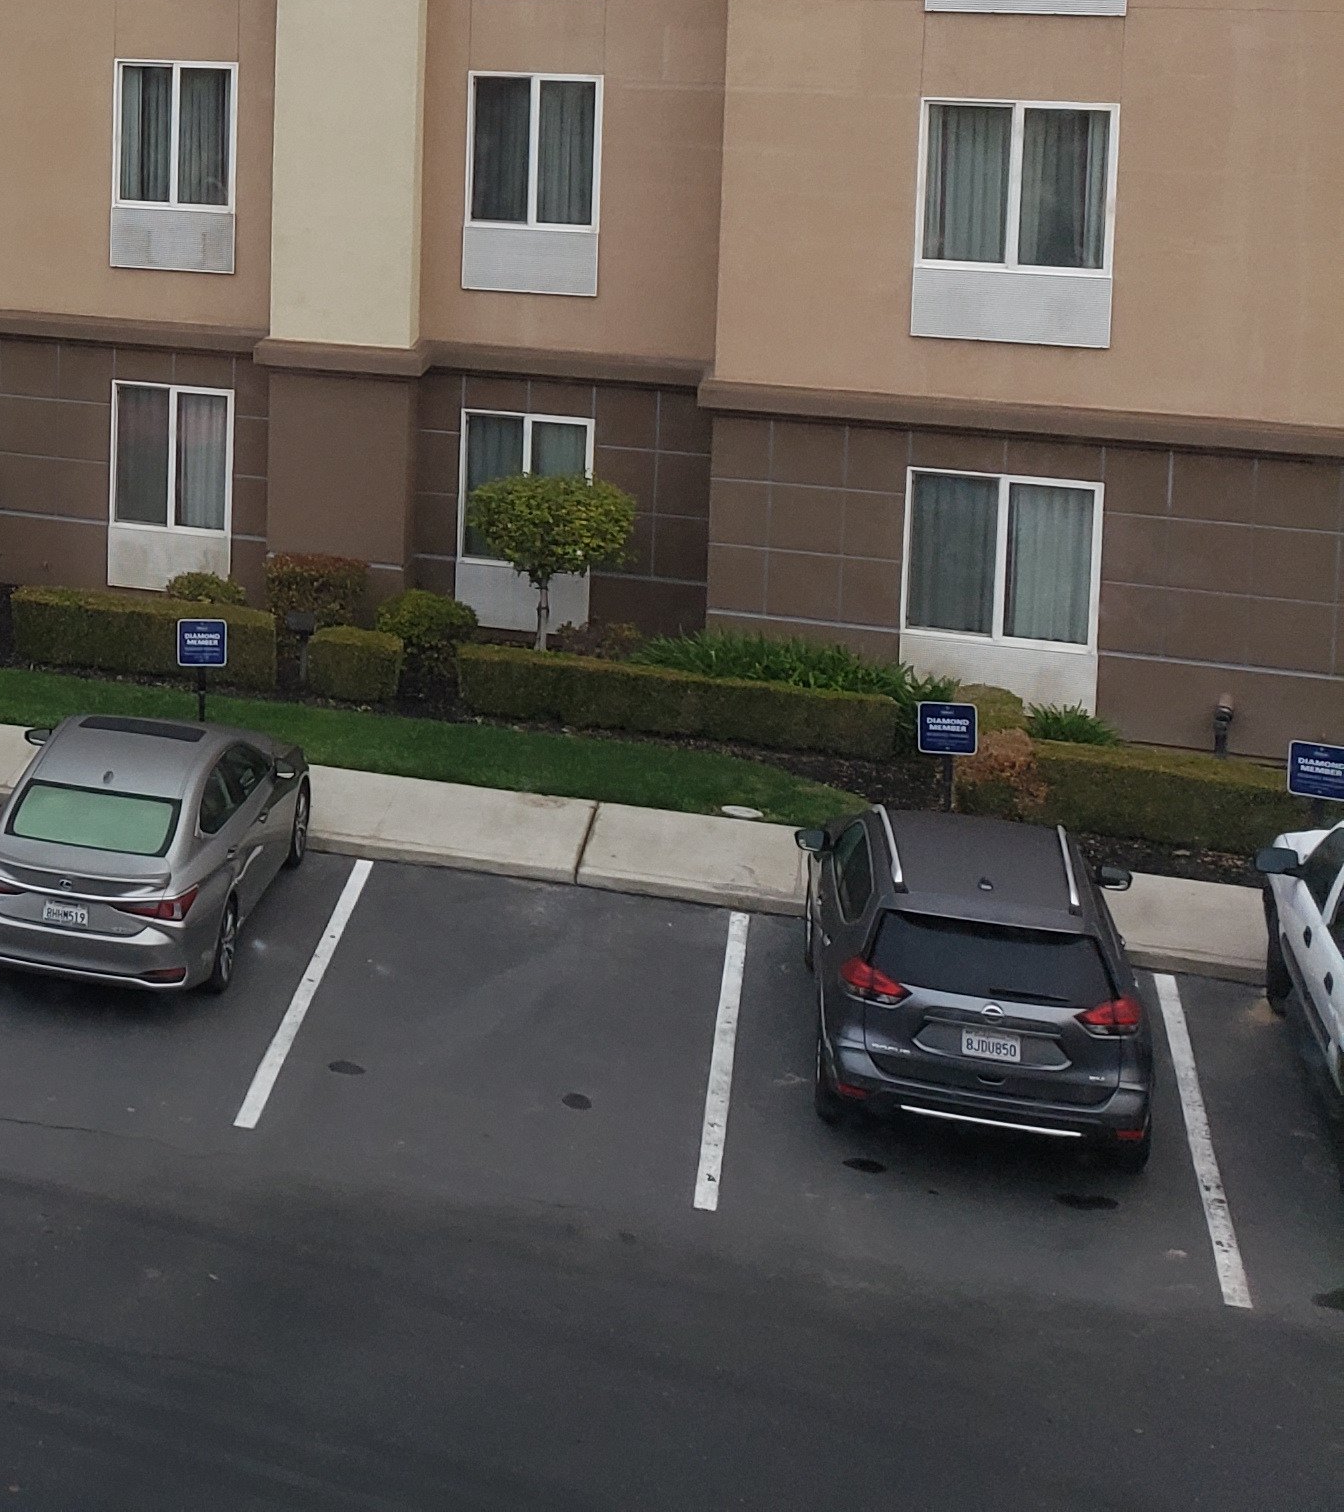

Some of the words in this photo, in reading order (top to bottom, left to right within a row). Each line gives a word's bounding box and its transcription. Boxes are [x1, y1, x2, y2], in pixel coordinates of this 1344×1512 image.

[184, 632, 221, 640] DIAMOND
[926, 717, 970, 726] DIAMOND
[928, 724, 967, 732] MEMBER
[1299, 765, 1343, 777] MEMBER
[966, 1038, 1017, 1057] 8JDU850
